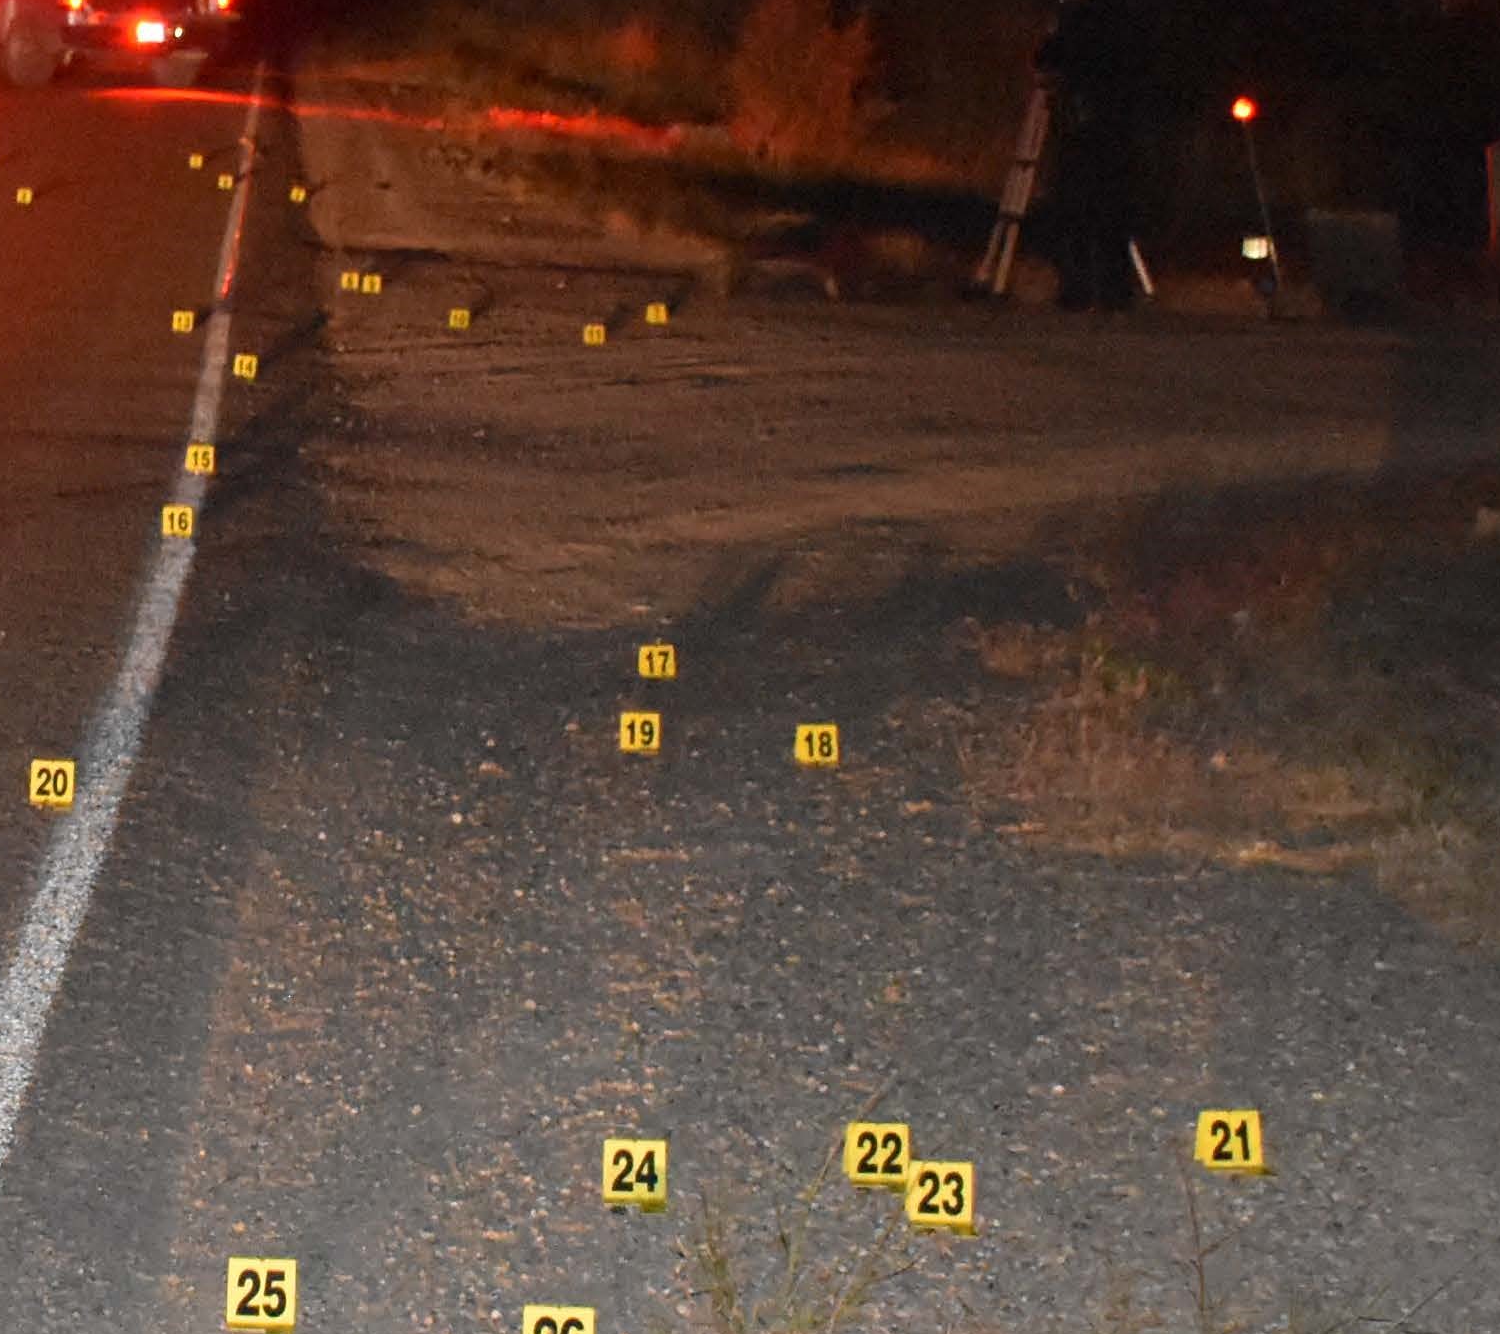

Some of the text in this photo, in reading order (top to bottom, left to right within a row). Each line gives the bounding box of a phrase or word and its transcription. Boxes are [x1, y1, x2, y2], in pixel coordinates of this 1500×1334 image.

[191, 450, 210, 468] 15
[167, 511, 189, 531] 16
[645, 650, 670, 674] 17
[626, 719, 655, 746] 19
[803, 730, 833, 758] 18
[36, 767, 68, 797] 20
[856, 1131, 903, 1174] 22
[1210, 1119, 1250, 1162] 21
[611, 1148, 659, 1193] 24
[917, 1170, 965, 1216] 23
[235, 1268, 287, 1318] 25
